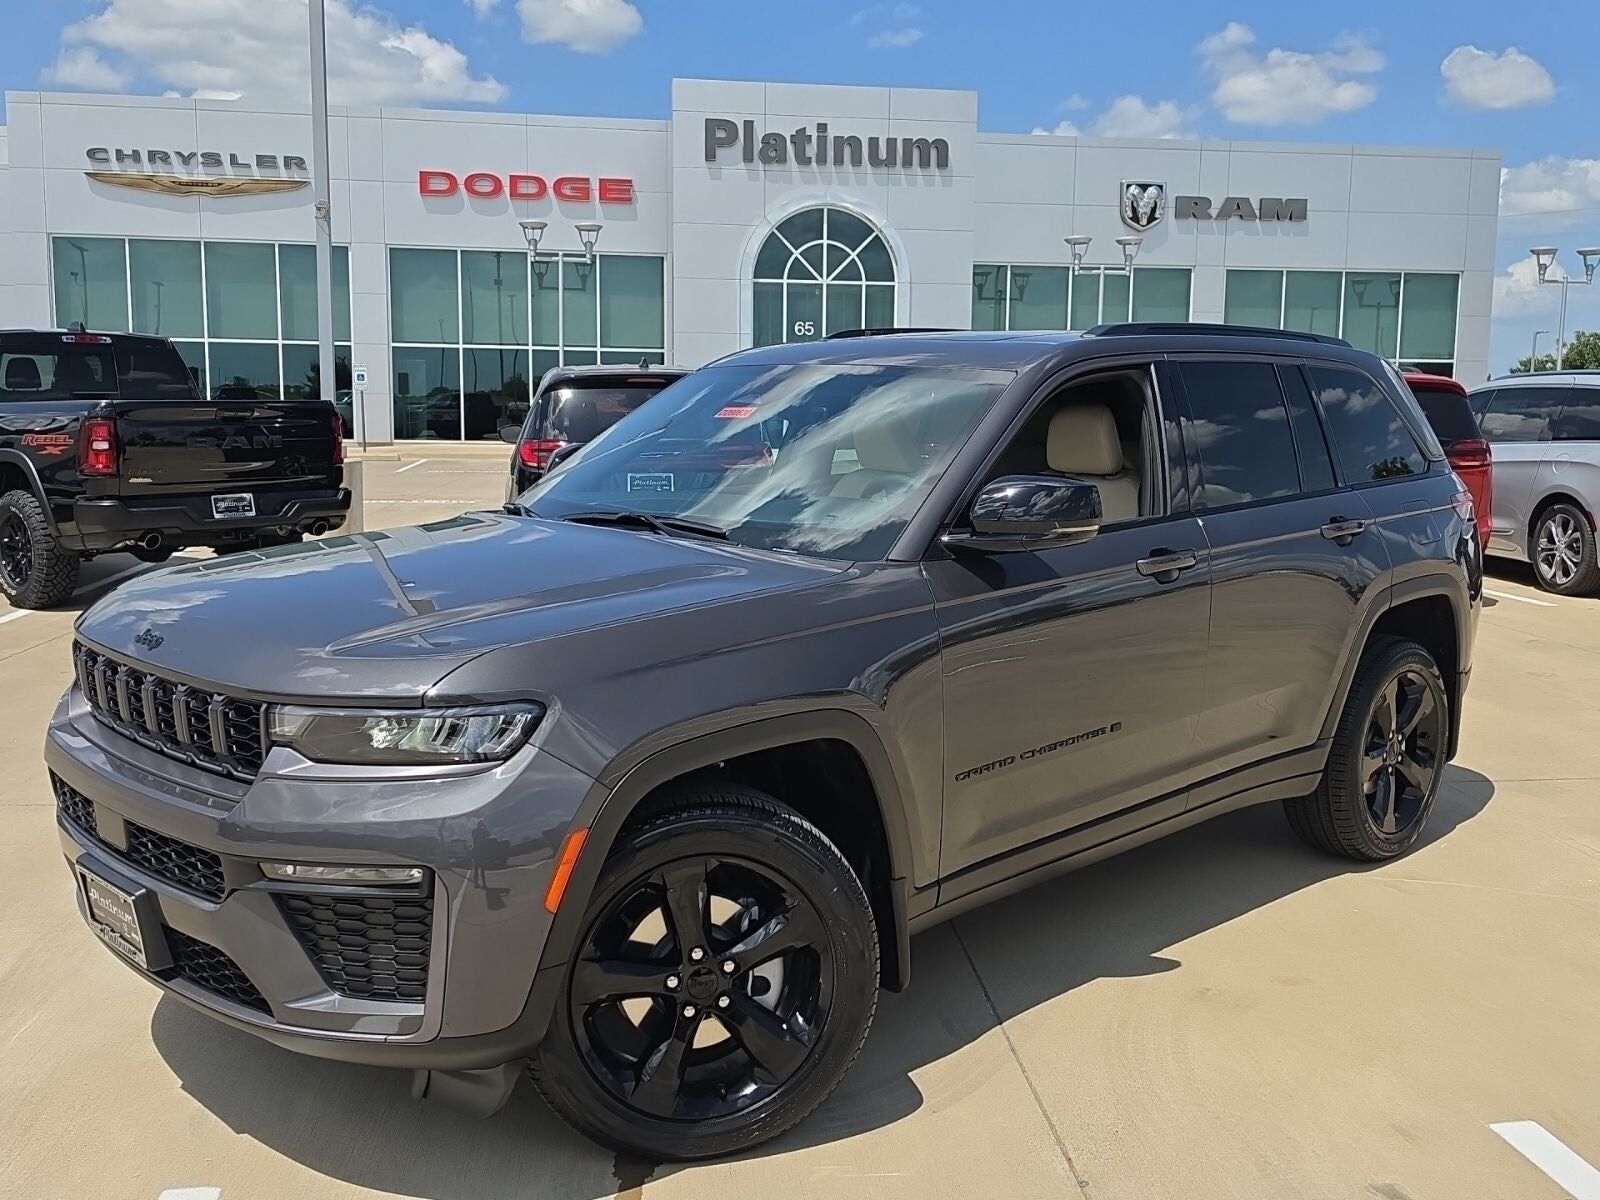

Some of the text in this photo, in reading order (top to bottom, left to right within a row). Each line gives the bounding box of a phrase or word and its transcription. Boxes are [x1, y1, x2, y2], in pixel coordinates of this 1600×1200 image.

[705, 118, 949, 169] Platinum
[85, 147, 307, 171] CHRYSLER
[419, 170, 633, 203] DODGE
[1174, 195, 1308, 221] RAM
[794, 321, 815, 336] 65
[21, 434, 74, 446] REBEL
[186, 435, 283, 449] RAM
[955, 726, 1107, 782] GRAND CHEROKEE
[88, 888, 137, 928] Platinum
